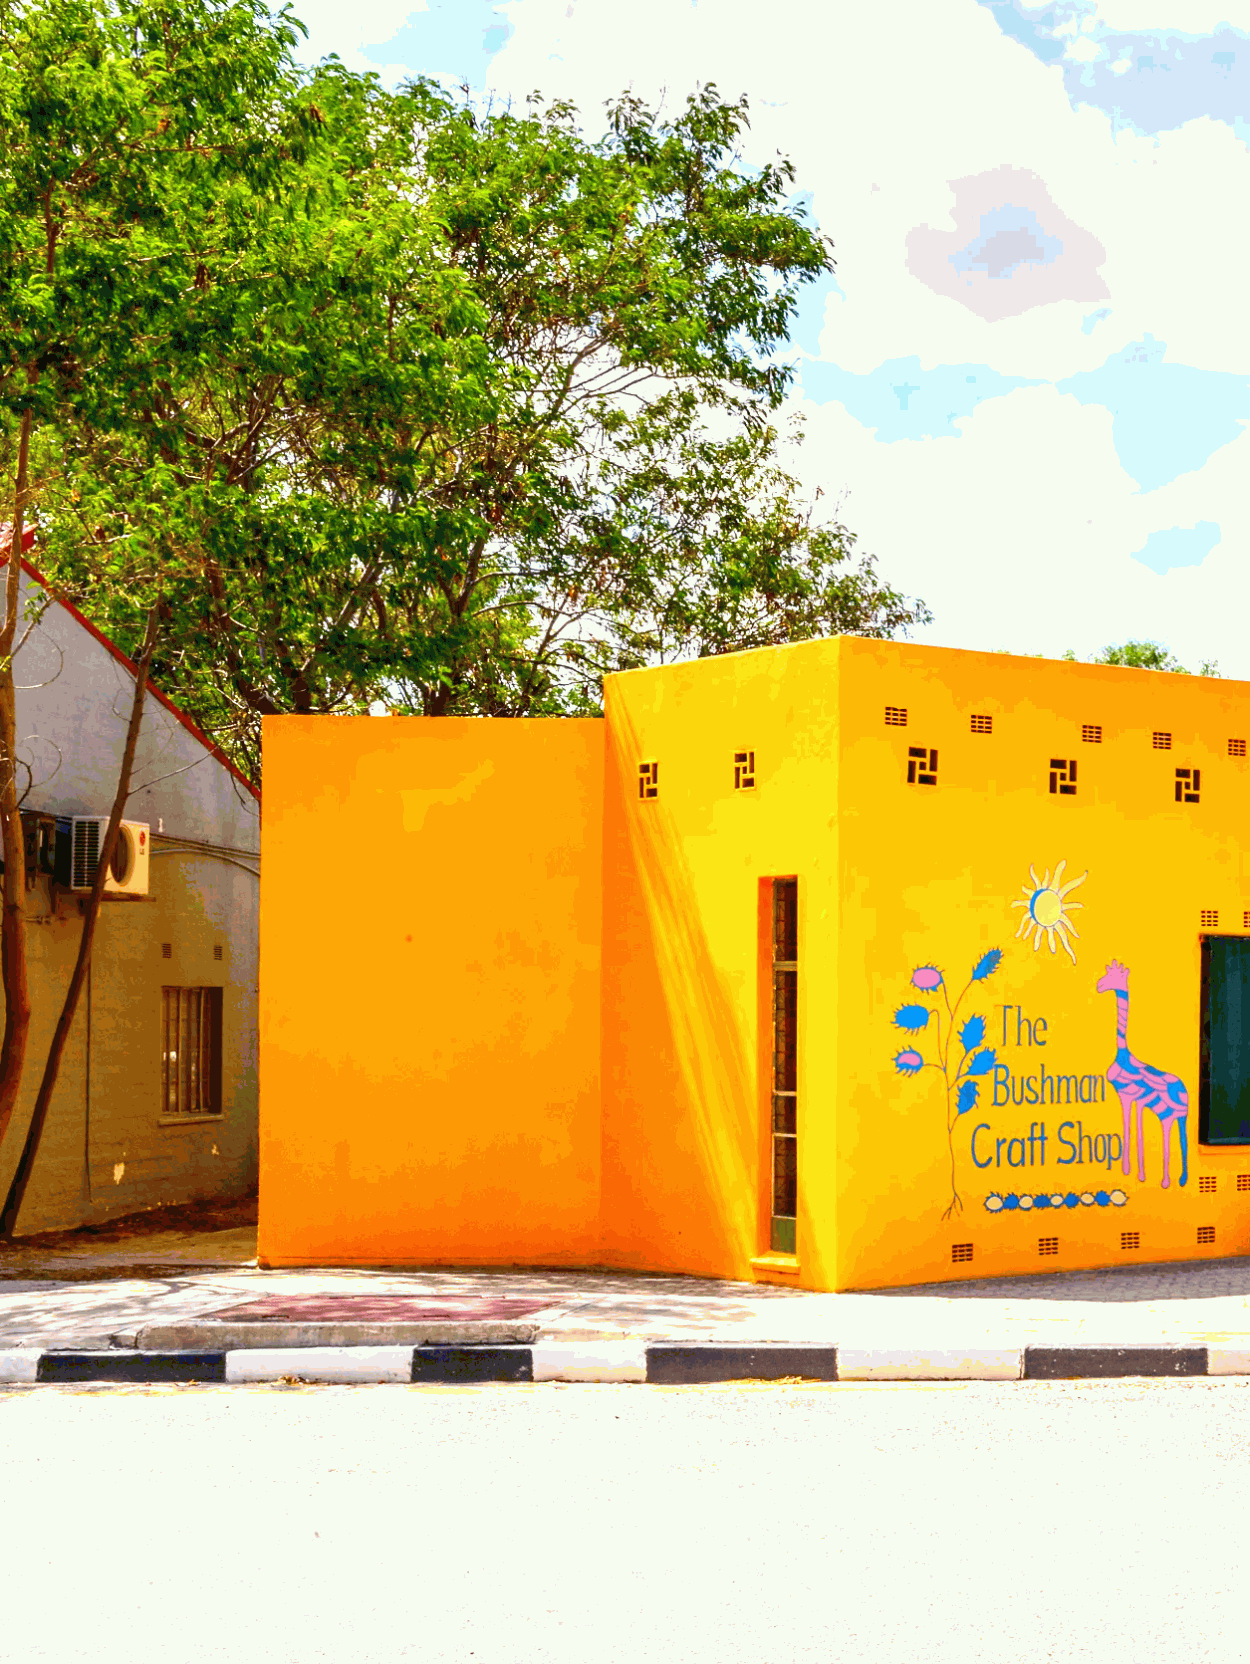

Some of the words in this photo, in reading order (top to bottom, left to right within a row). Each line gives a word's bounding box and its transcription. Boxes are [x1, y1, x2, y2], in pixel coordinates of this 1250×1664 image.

[994, 1005, 1047, 1047] The
[990, 1063, 1105, 1107] Bushman
[971, 1122, 1048, 1169] Craft
[1057, 1121, 1123, 1170] Shop
